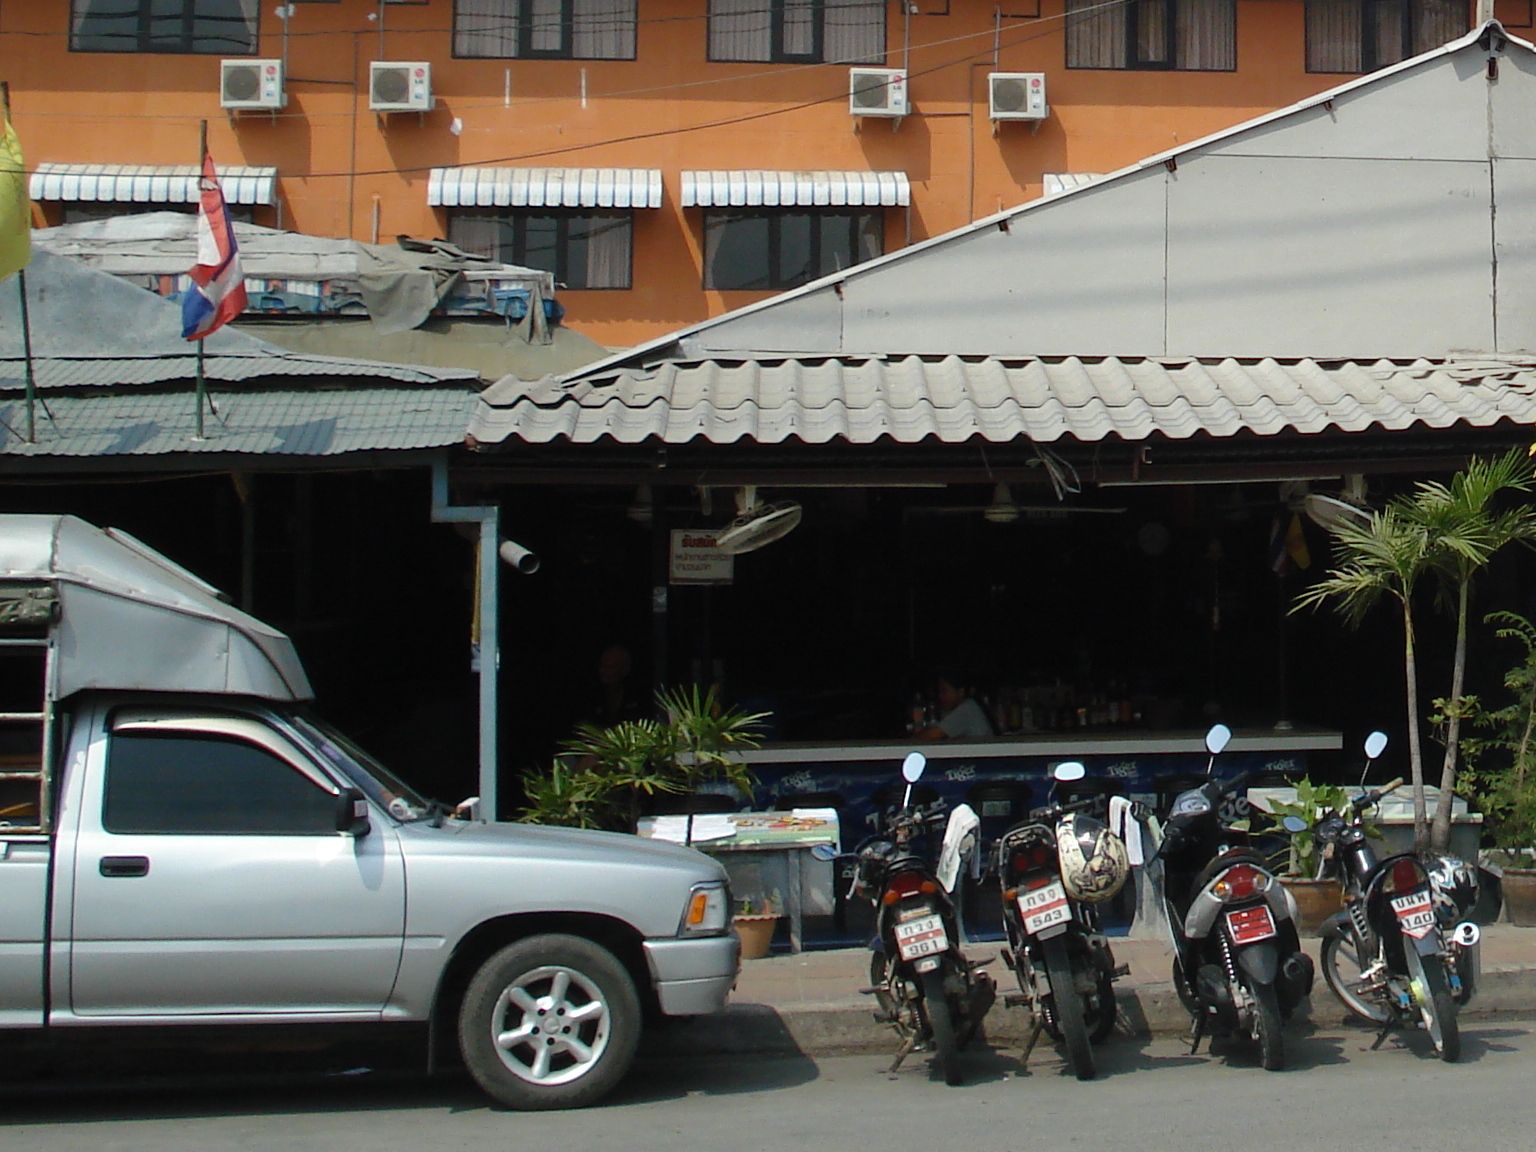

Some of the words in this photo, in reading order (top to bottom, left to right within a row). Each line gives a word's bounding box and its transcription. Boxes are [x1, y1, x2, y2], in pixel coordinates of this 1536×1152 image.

[1106, 761, 1137, 778] Tiger
[1265, 759, 1295, 772] Tiger
[1032, 909, 1063, 928] 543
[1403, 912, 1433, 928] 140
[909, 940, 938, 956] 961
